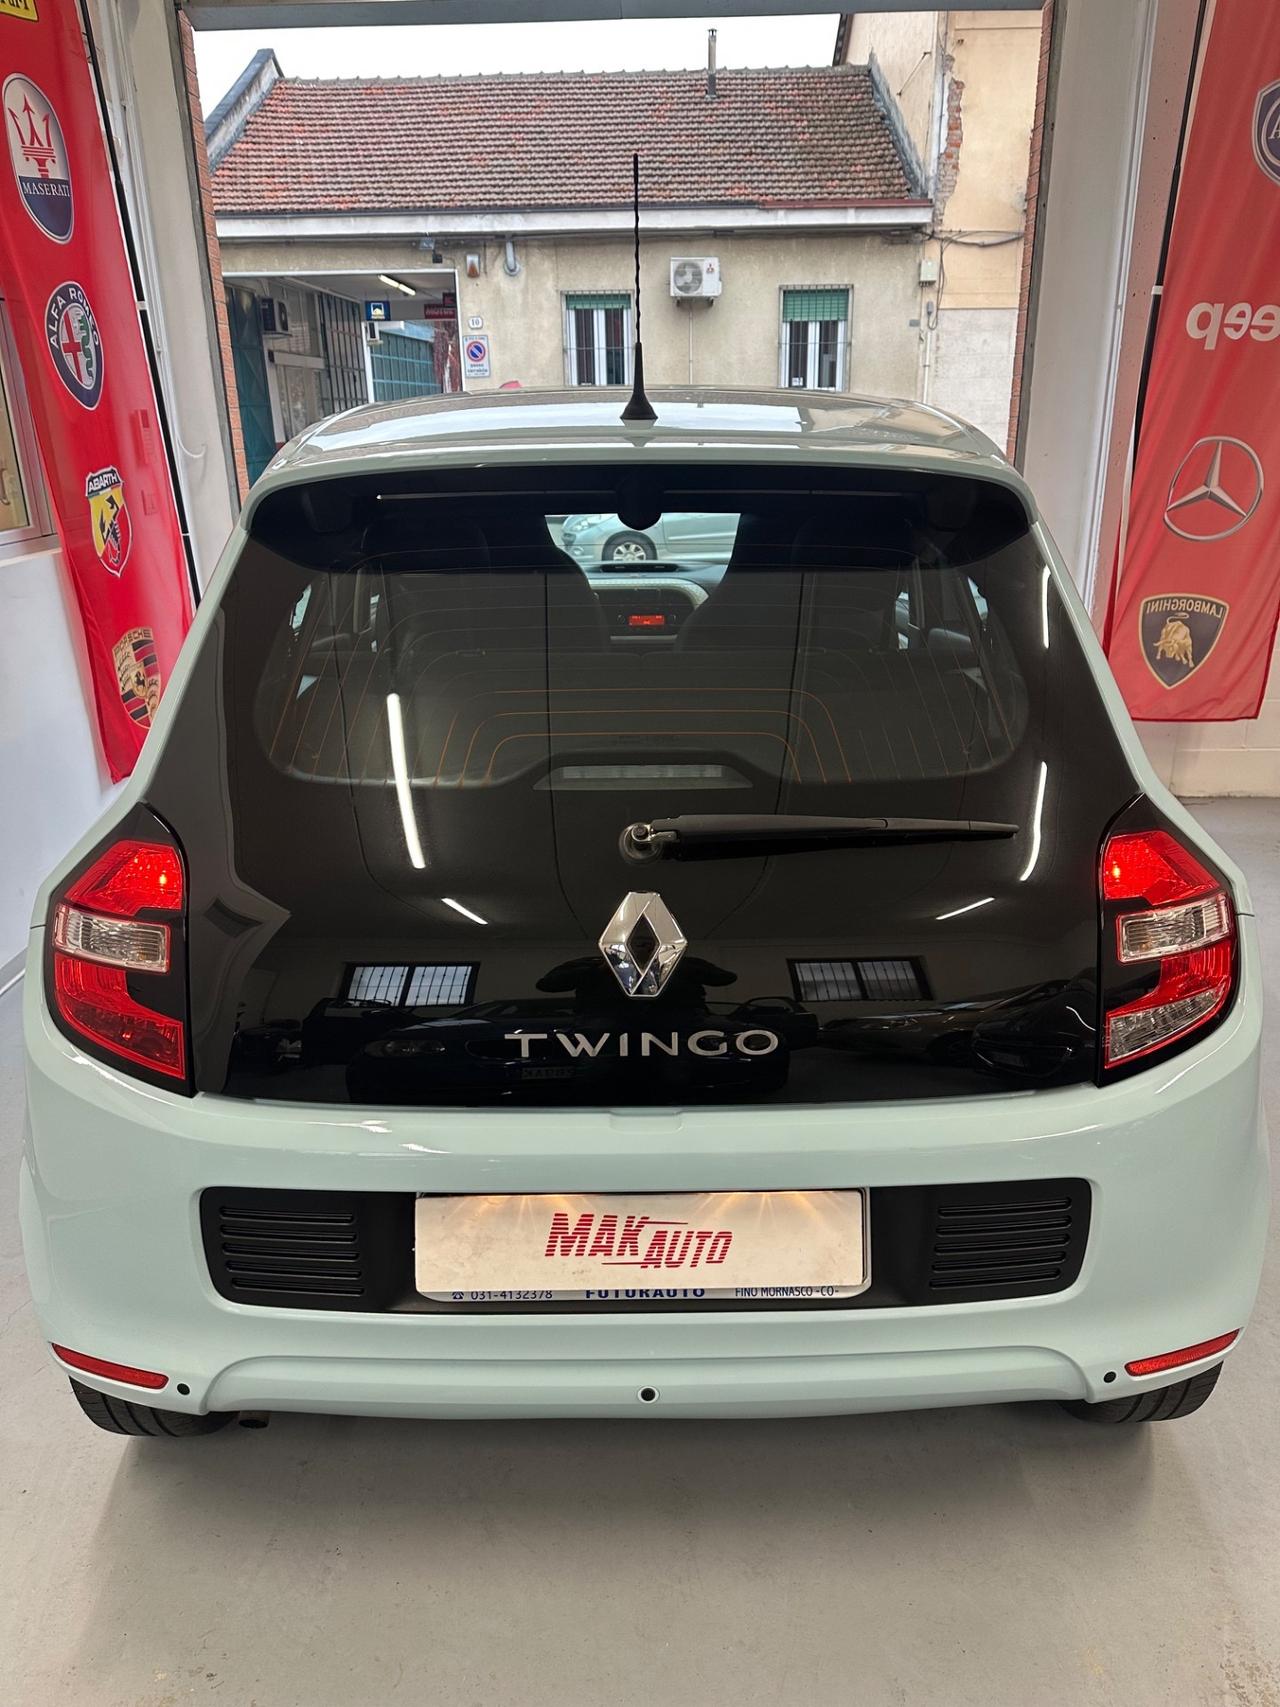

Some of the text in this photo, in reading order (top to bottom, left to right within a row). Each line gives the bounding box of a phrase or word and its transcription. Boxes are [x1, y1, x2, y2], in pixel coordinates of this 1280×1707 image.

[22, 181, 71, 197] MASERATI
[49, 295, 67, 349] ALFA
[88, 472, 119, 493] ABARTH
[504, 1029, 779, 1058] TWINGO
[544, 1212, 733, 1269] MAK AUTO
[760, 1286, 813, 1297] MORNASCO
